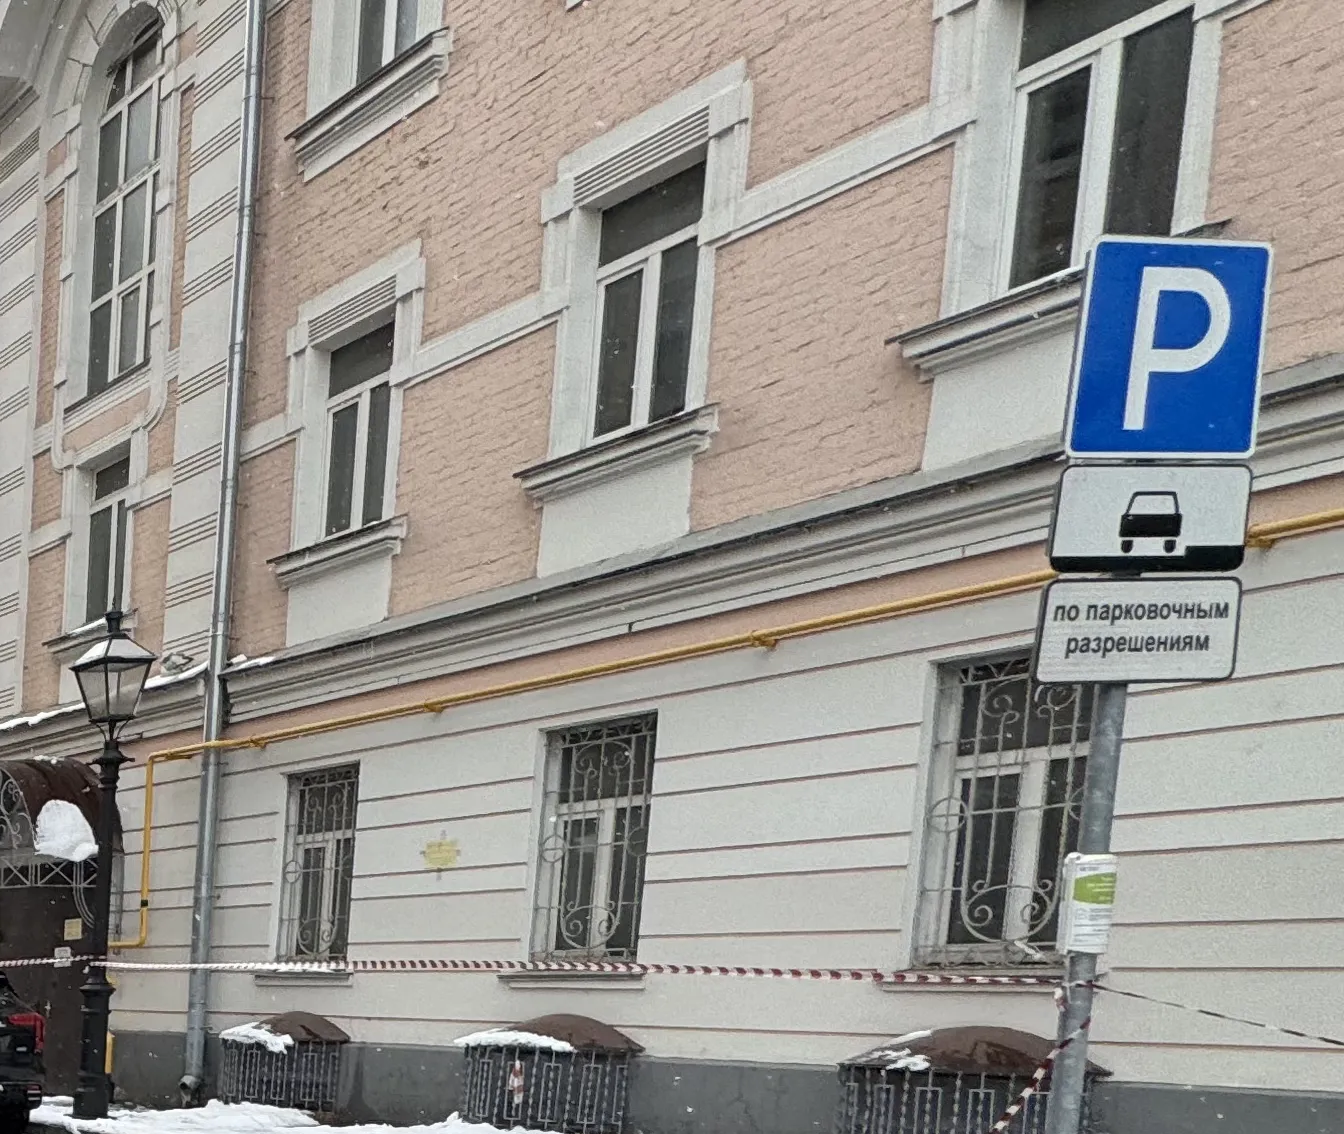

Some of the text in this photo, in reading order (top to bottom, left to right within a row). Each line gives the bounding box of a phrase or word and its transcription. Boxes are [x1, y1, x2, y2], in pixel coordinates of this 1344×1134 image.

[1122, 266, 1231, 431] P
[1053, 602, 1230, 626] по парковочным
[1064, 635, 1210, 659] разрешениям
